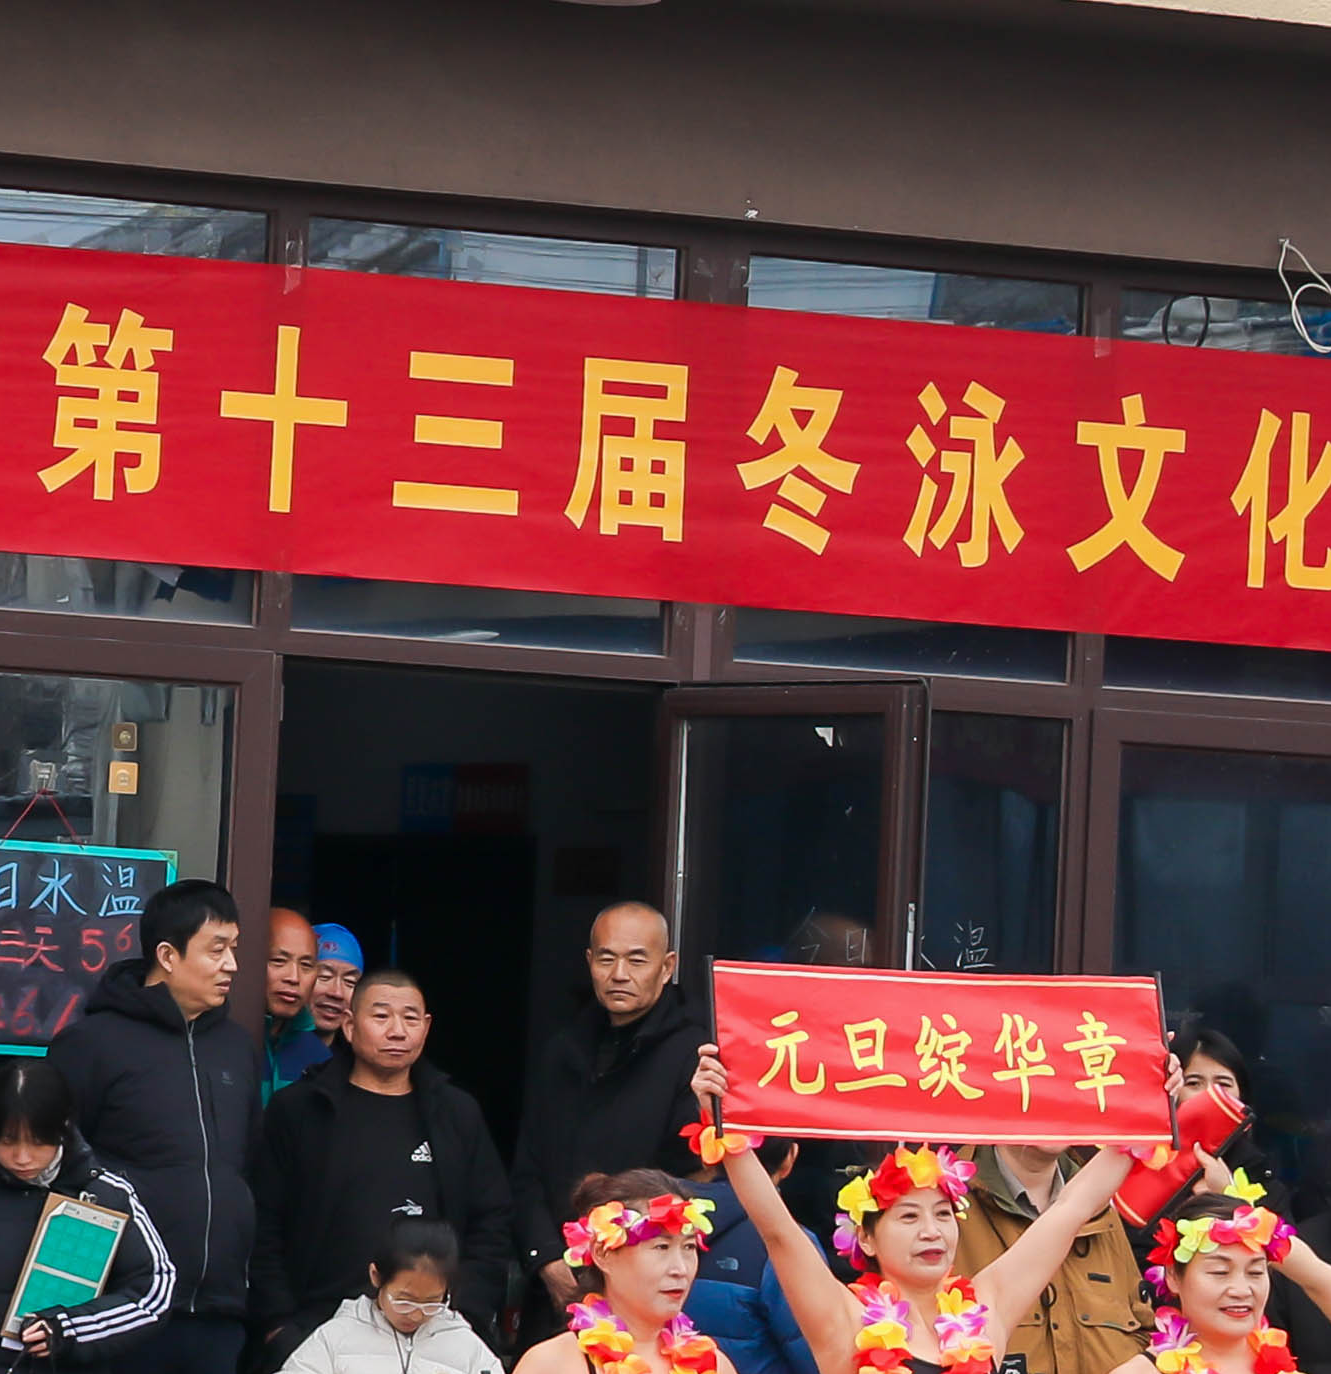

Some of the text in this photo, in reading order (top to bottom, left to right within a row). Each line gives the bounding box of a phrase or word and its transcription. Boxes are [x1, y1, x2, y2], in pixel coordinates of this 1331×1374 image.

[757, 1010, 1128, 1113] 元旦绽华章
